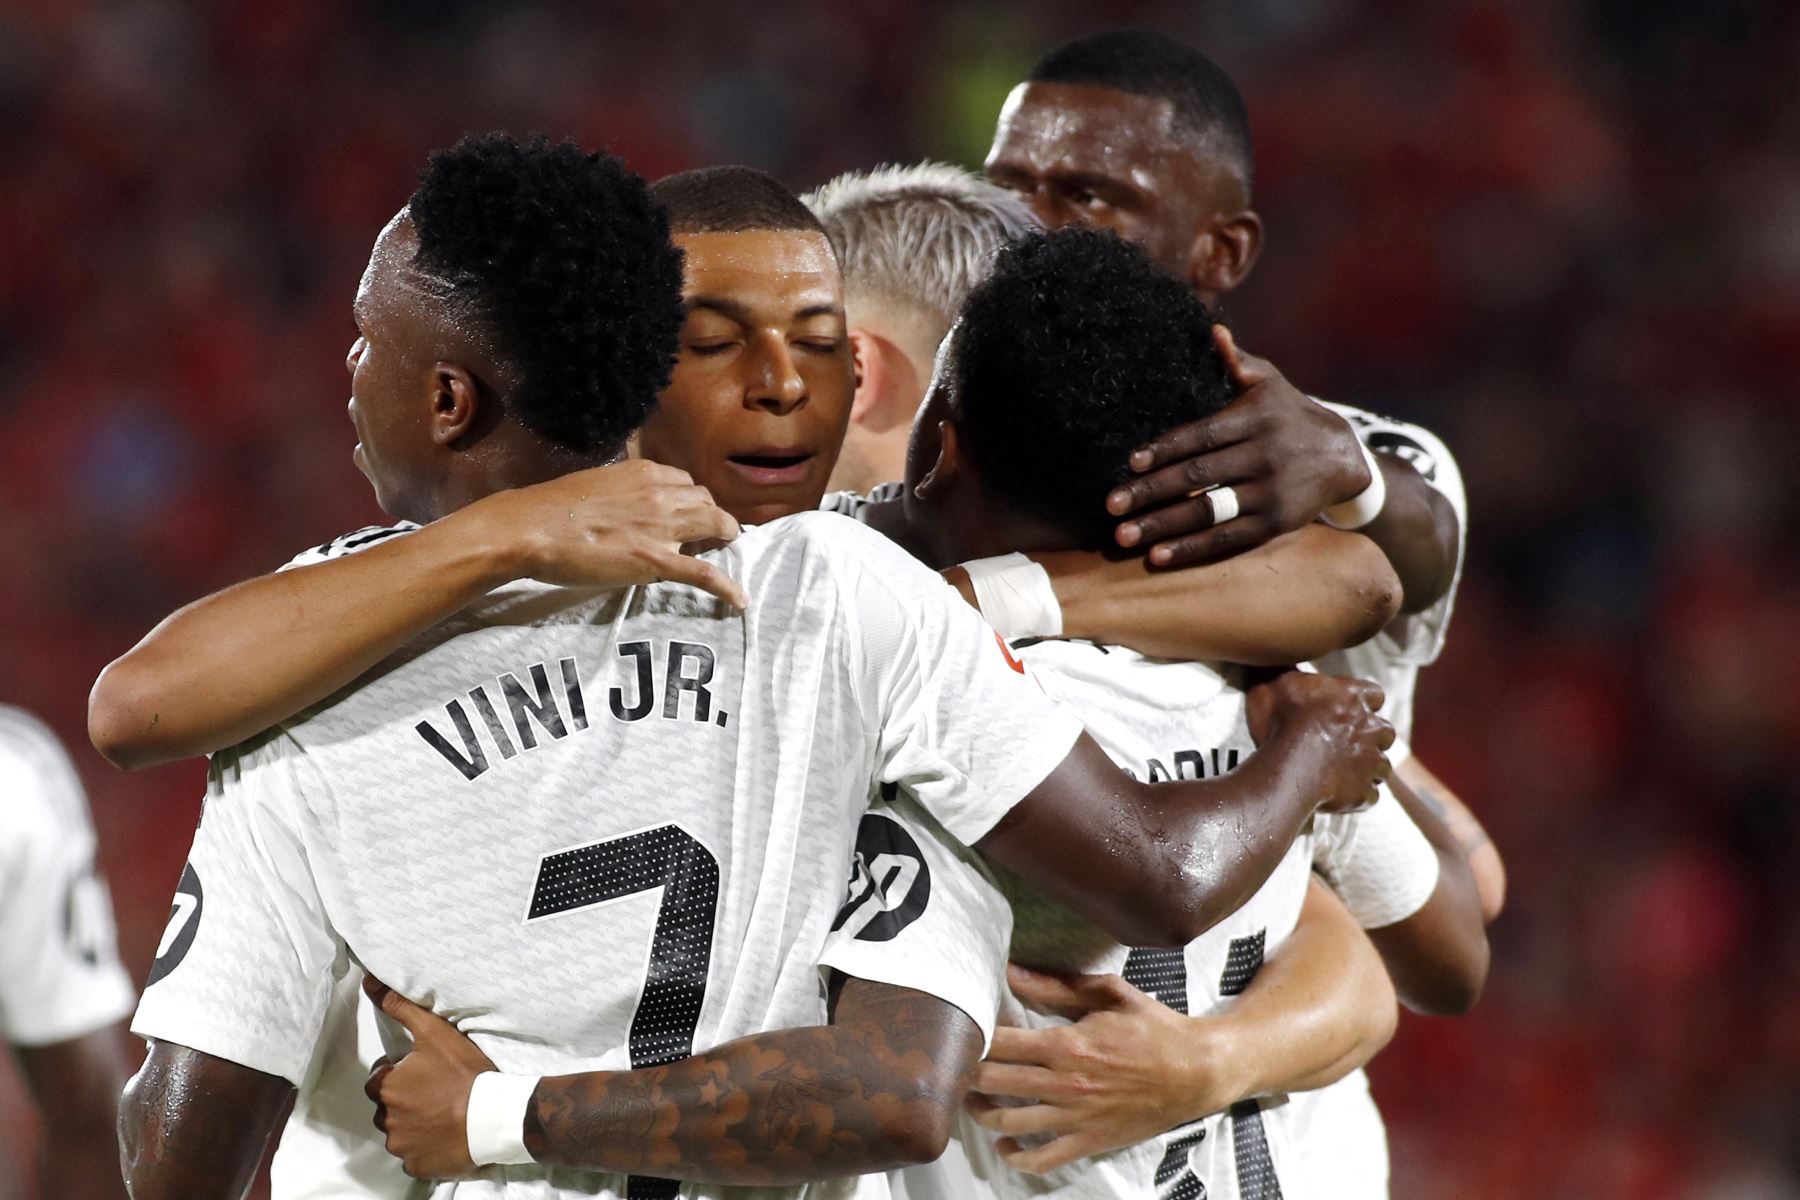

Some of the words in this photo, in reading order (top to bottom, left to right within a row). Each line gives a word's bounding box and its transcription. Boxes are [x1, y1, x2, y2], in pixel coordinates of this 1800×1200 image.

[414, 656, 590, 782] VINI
[608, 640, 729, 729] JR.
[522, 820, 720, 1200] 7
